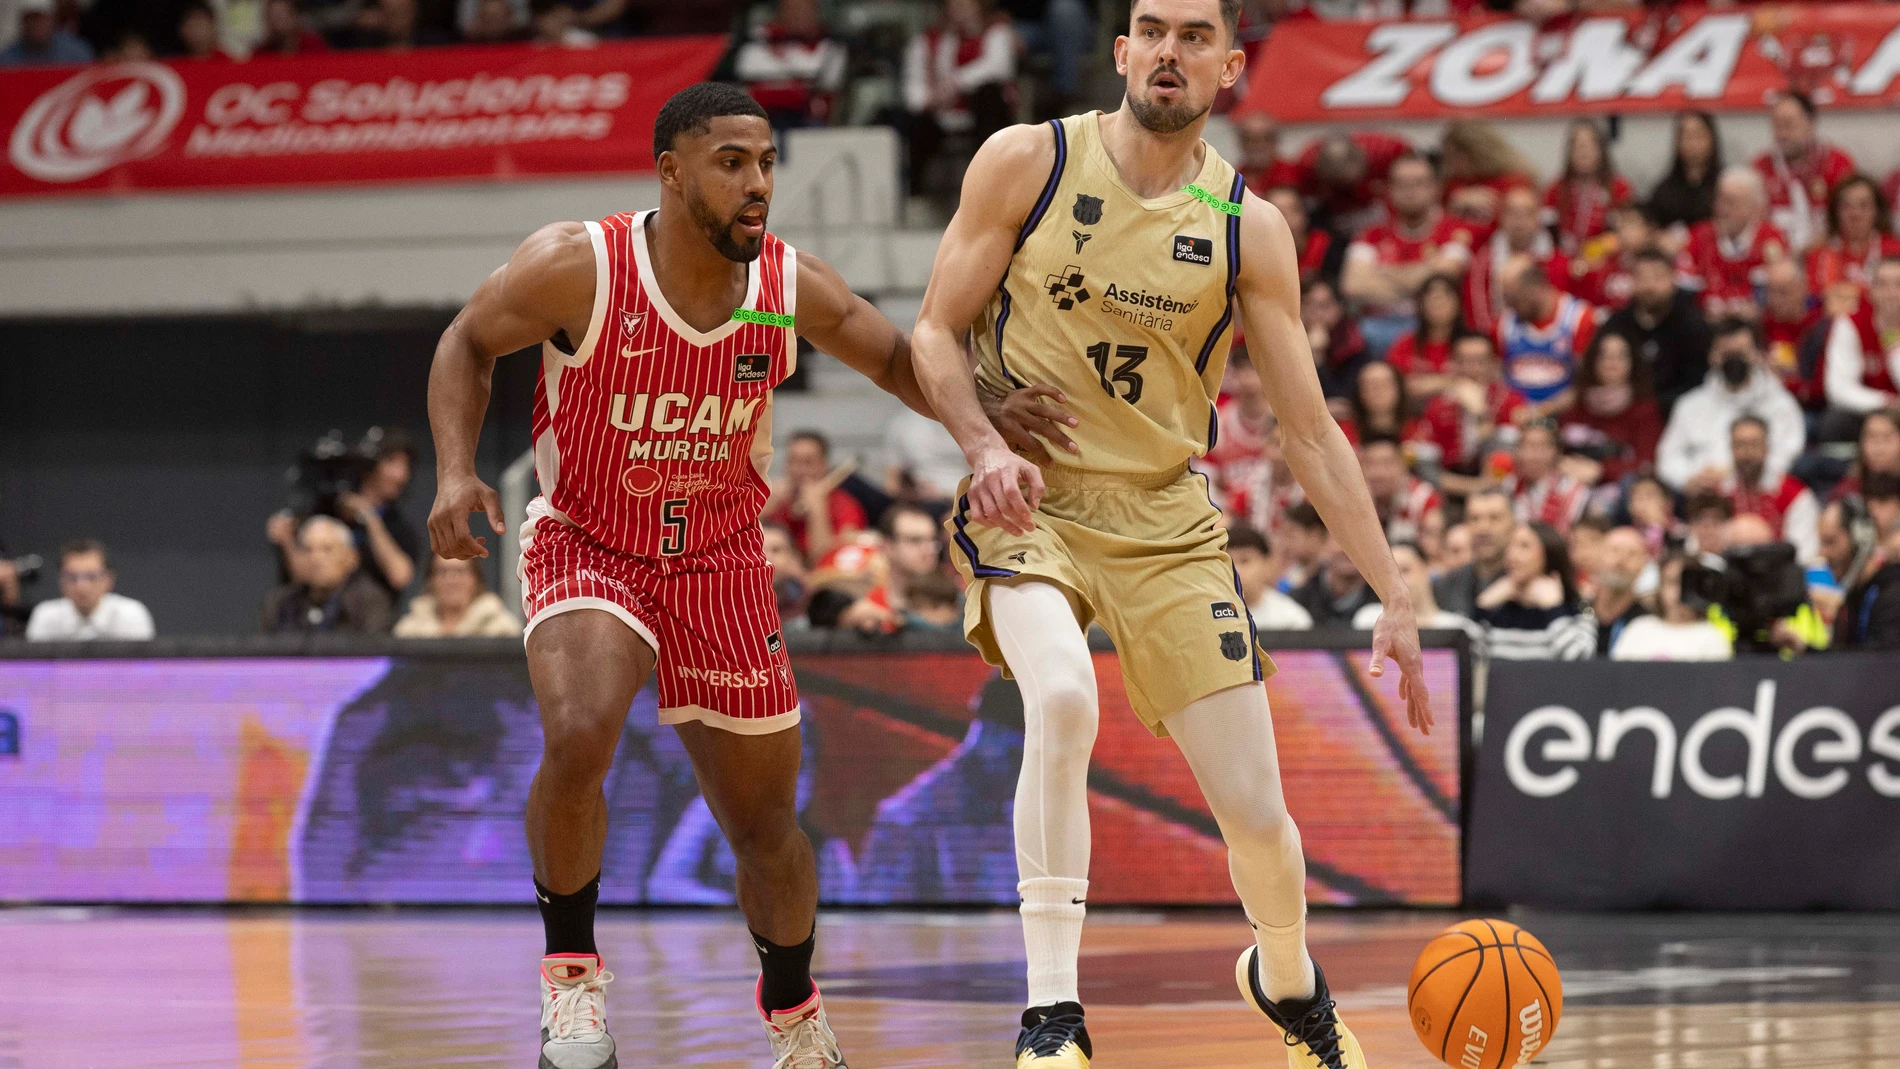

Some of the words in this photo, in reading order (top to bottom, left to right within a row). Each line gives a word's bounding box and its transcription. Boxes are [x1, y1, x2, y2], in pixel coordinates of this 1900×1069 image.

[1321, 14, 1751, 107] ZONA
[205, 83, 300, 125] OC
[302, 72, 632, 121] Soluciones
[1176, 252, 1210, 262] endesa
[1177, 242, 1193, 252] liga
[1101, 300, 1173, 331] Sanitària
[737, 370, 766, 379] endesa
[738, 363, 752, 372] liga
[1087, 341, 1149, 405] 13
[610, 392, 762, 436] UCAM
[628, 439, 729, 462] MURCIA
[661, 499, 688, 555] 5
[1214, 607, 1235, 617] acb
[678, 665, 769, 688] INVERSUS
